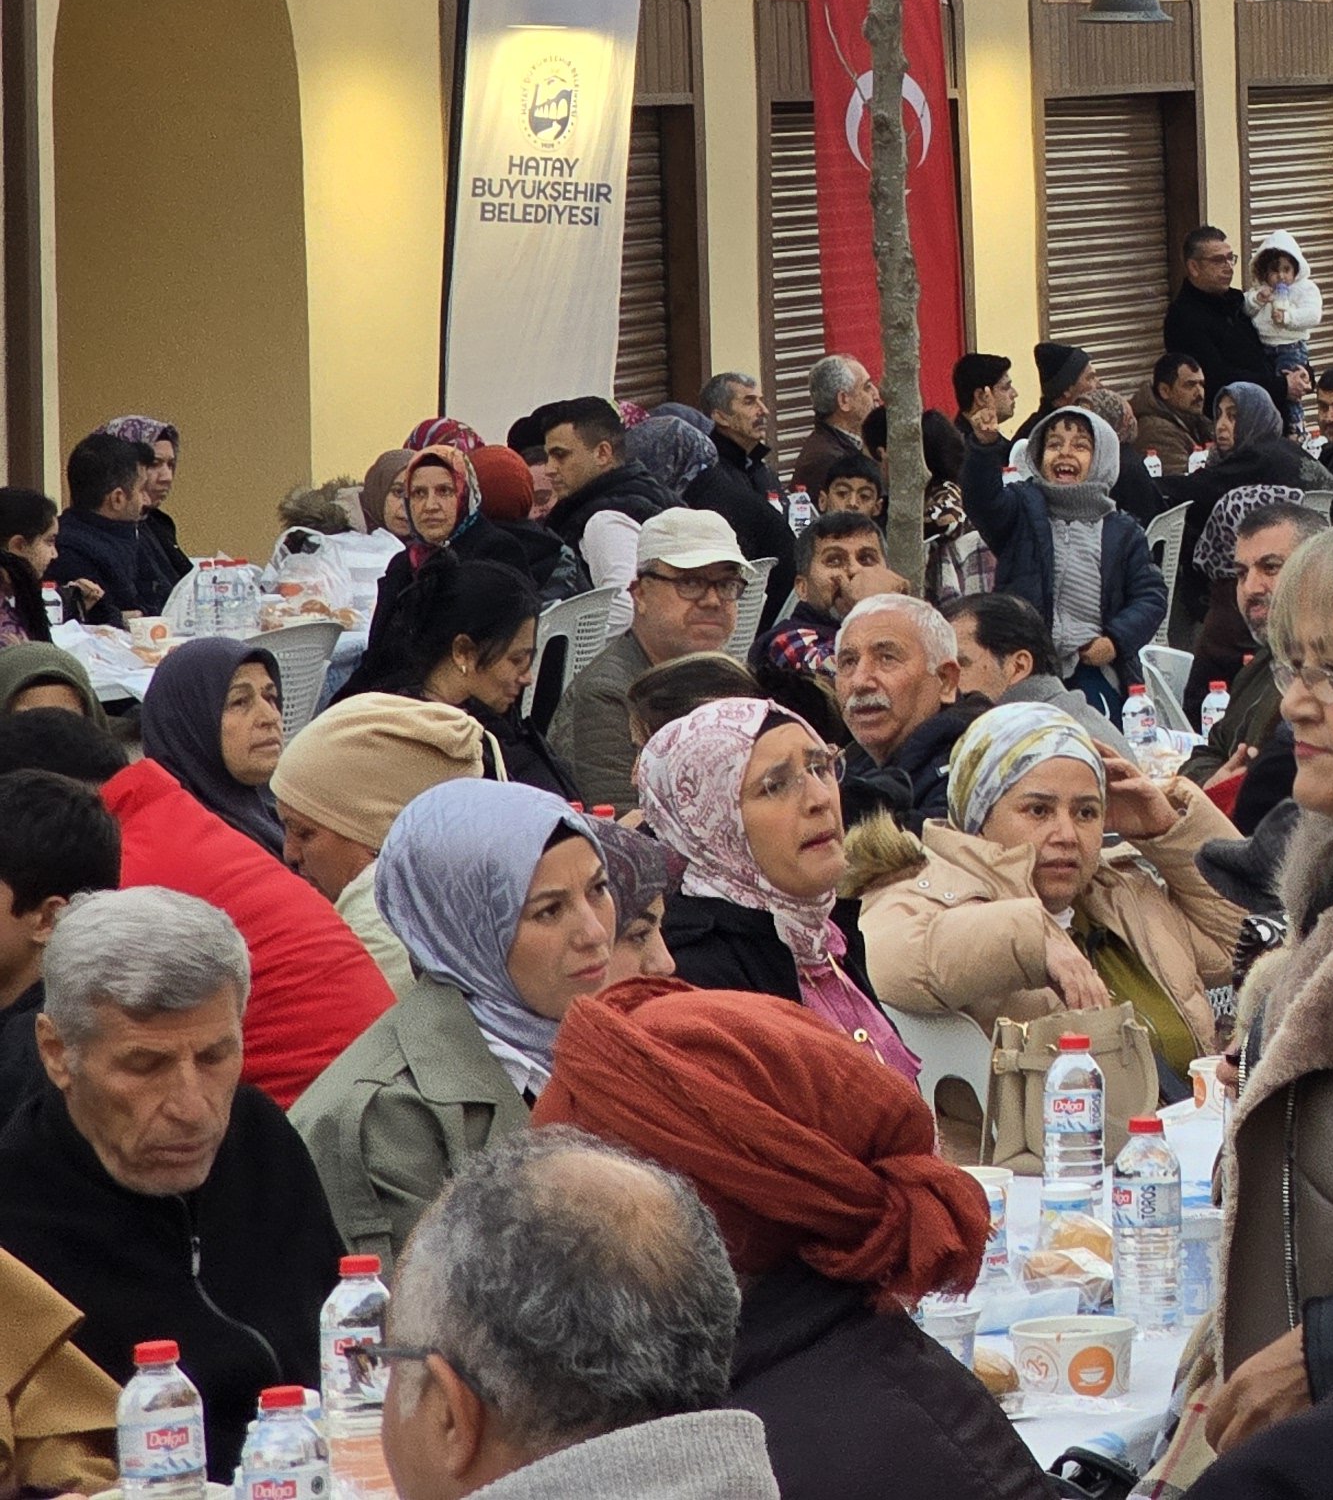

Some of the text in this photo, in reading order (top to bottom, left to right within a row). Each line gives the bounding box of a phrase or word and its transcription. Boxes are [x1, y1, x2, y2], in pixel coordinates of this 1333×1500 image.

[508, 155, 579, 178] HATAY
[480, 202, 600, 226] BELEDİYESİ
[1054, 1100, 1084, 1113] Dalga
[1141, 1185, 1156, 1220] TOROS
[149, 1431, 187, 1448] Dalga
